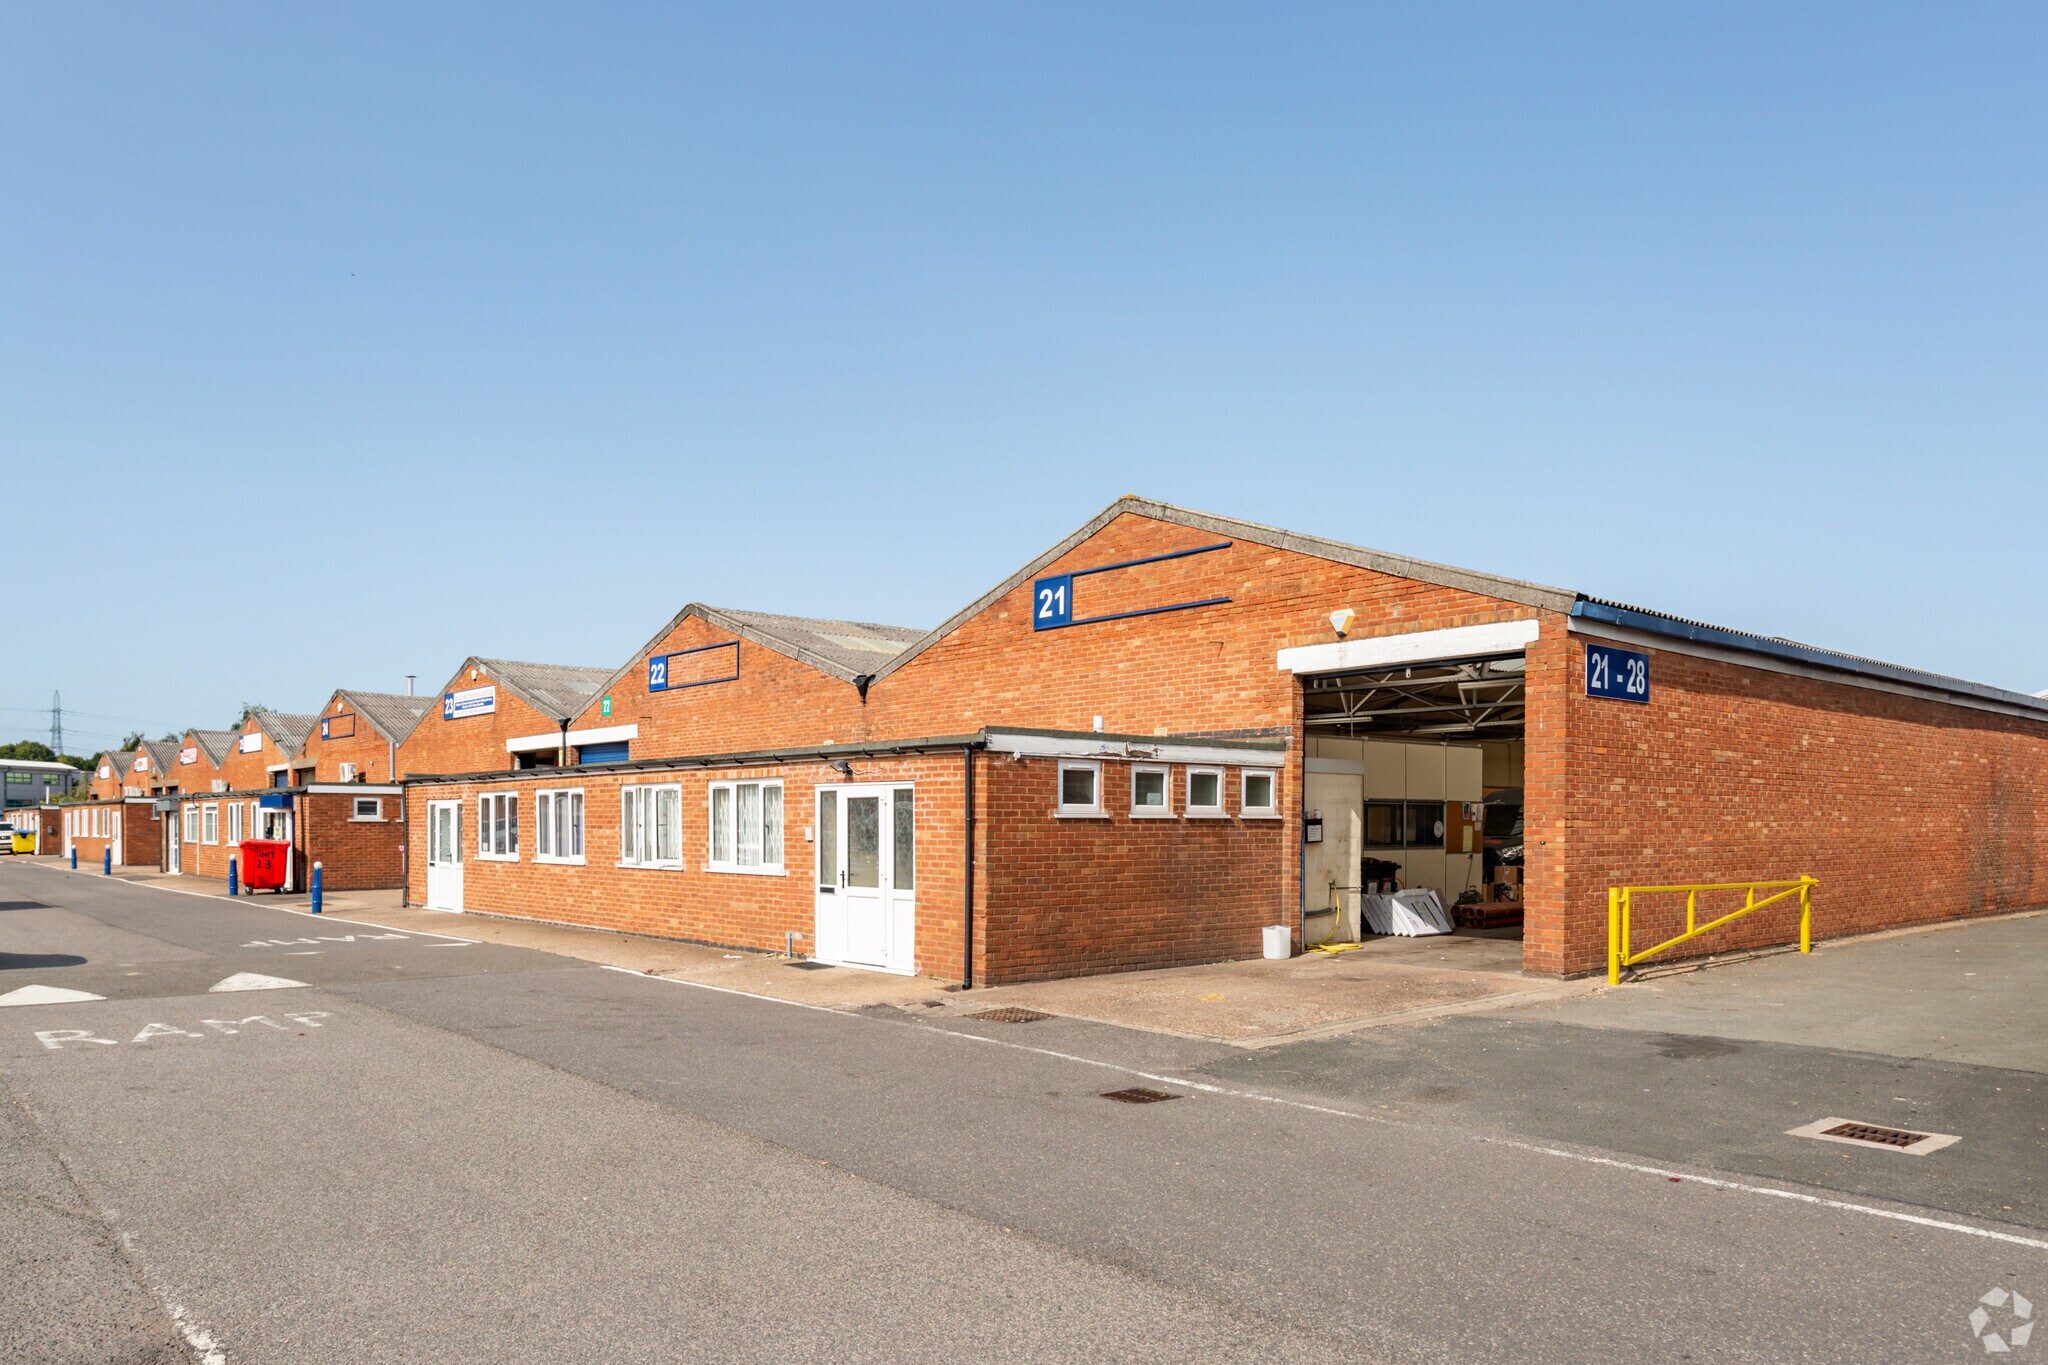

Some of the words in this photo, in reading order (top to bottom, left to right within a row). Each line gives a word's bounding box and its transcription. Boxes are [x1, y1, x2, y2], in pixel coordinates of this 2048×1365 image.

[1039, 586, 1064, 618] 21
[651, 663, 665, 684] 22
[1591, 653, 1608, 689] 21
[1627, 659, 1645, 694] 28
[445, 698, 453, 714] 23
[257, 860, 271, 869] 23
[34, 1012, 333, 1049] RAMP
